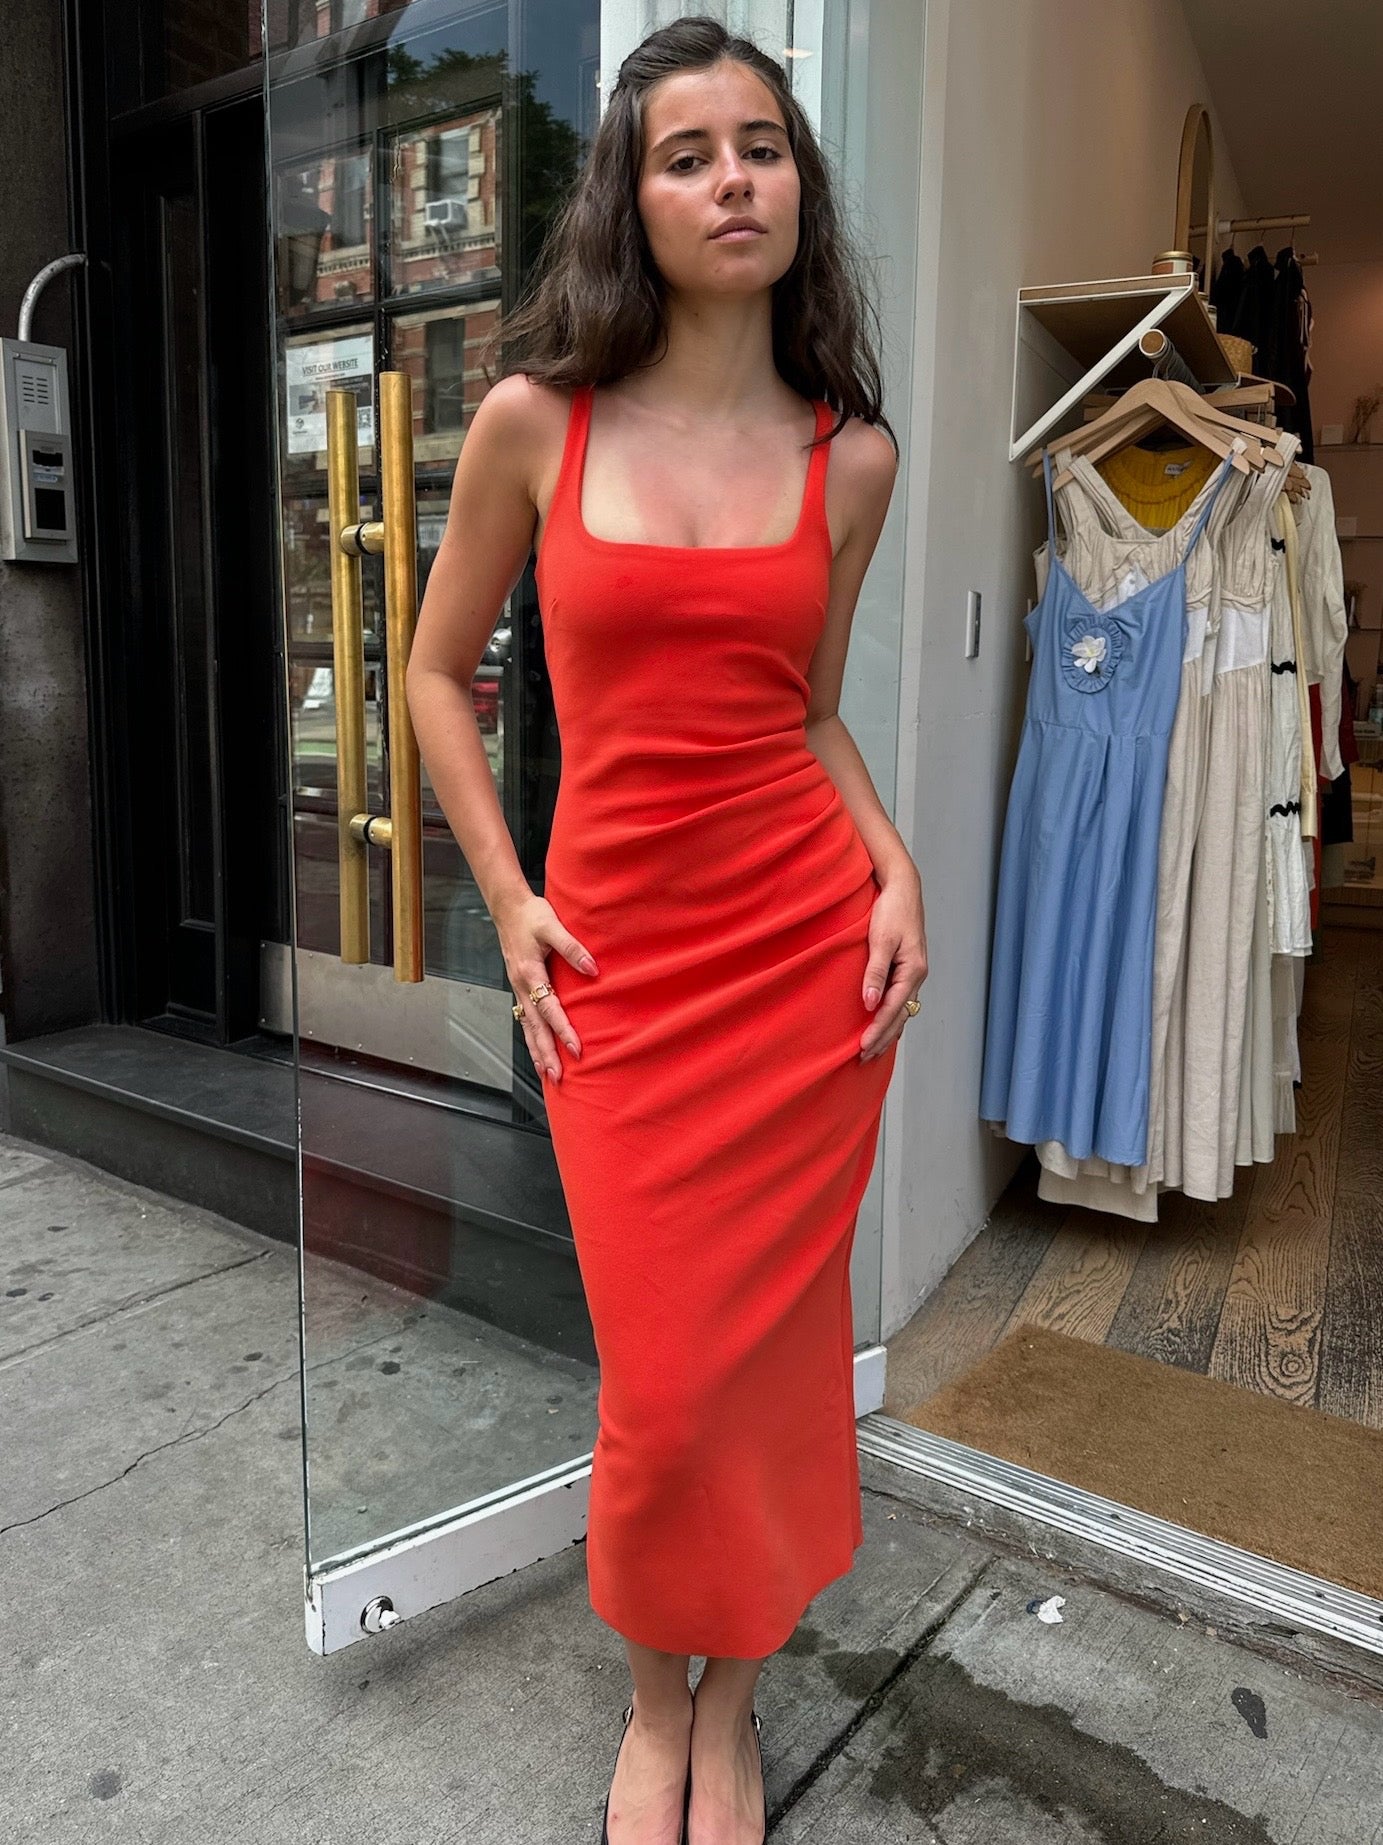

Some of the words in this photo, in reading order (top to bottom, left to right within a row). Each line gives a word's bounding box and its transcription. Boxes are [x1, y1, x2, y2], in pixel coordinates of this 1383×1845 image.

[302, 364, 317, 375] VISIT
[318, 362, 331, 372] OUR
[332, 358, 358, 370] WEBSITE
